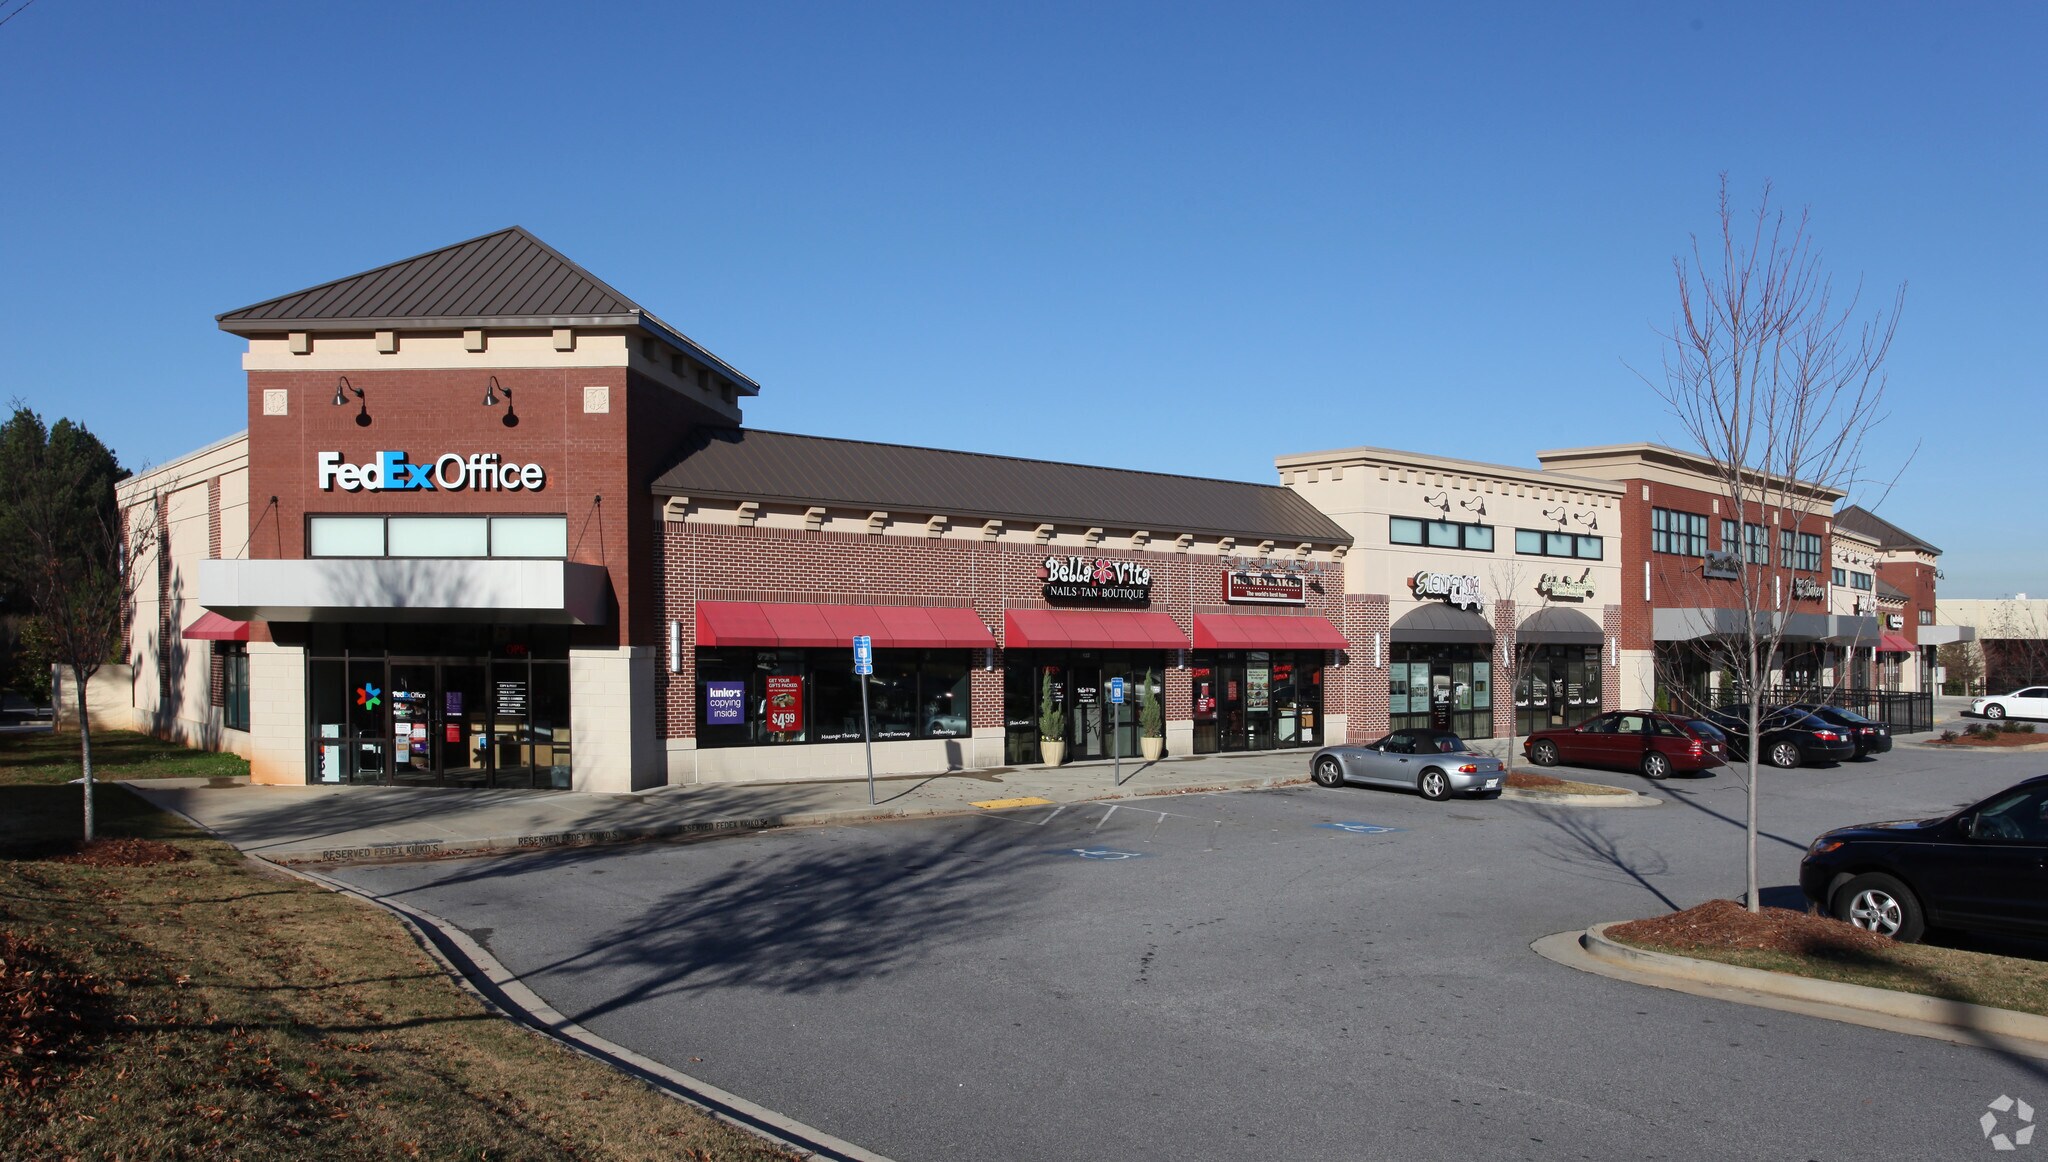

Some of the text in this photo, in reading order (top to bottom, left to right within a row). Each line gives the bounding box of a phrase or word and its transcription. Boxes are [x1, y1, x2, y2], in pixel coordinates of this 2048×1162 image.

[318, 451, 543, 490] FedEx Office
[1046, 556, 1150, 585] Bella Vita
[1233, 576, 1301, 588] HONEYBAKED
[1050, 586, 1144, 600] NAILS TAN BOUTIQUE
[710, 688, 741, 697] kinko's
[710, 698, 741, 708] copying
[714, 708, 737, 717] inside
[518, 834, 559, 846] RESERVED
[323, 848, 371, 859] RESERVED
[374, 846, 403, 856] FEDEX
